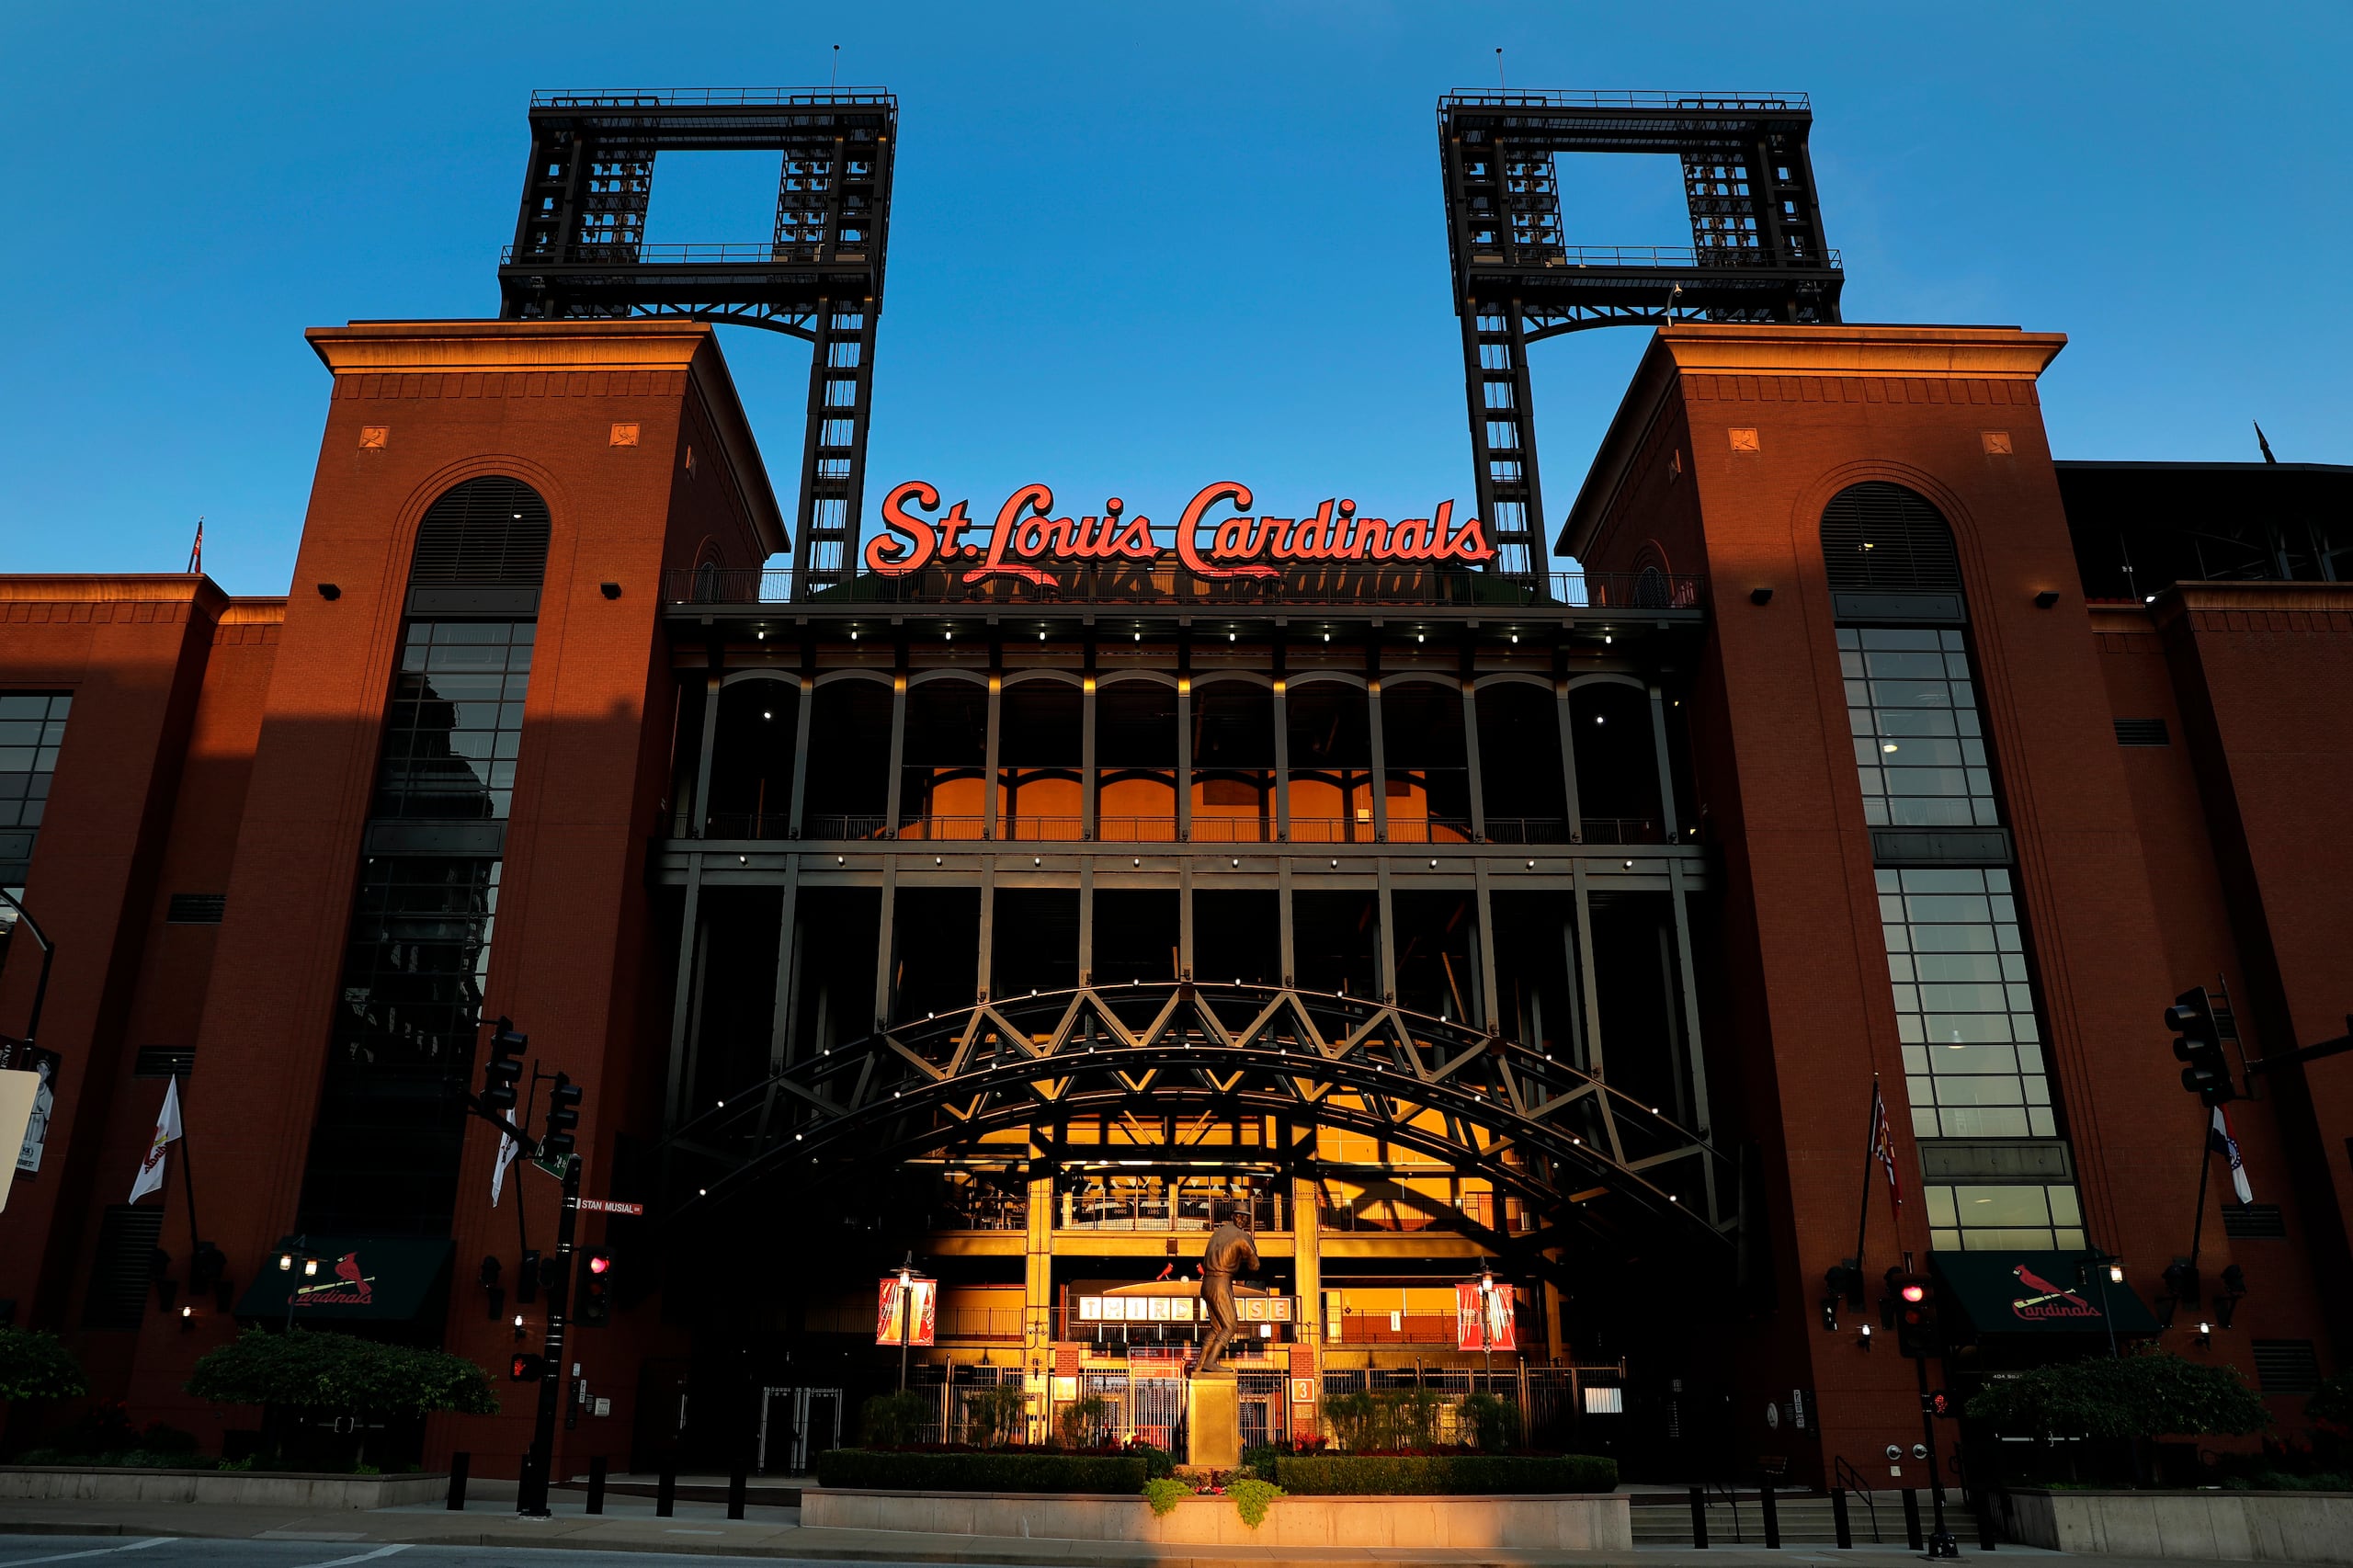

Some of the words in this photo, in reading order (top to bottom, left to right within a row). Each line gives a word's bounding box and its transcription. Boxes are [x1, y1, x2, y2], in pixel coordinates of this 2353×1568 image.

[865, 481, 980, 577] St.
[962, 483, 1163, 588] Louis
[1175, 481, 1499, 582] Cardinals
[582, 1199, 602, 1210] STAN
[605, 1202, 633, 1213] MUSIAL
[287, 1284, 373, 1307] Cardinals
[1086, 1301, 1188, 1318] THIRD
[2011, 1298, 2104, 1321] Cardinals
[1299, 1381, 1308, 1399] 3
